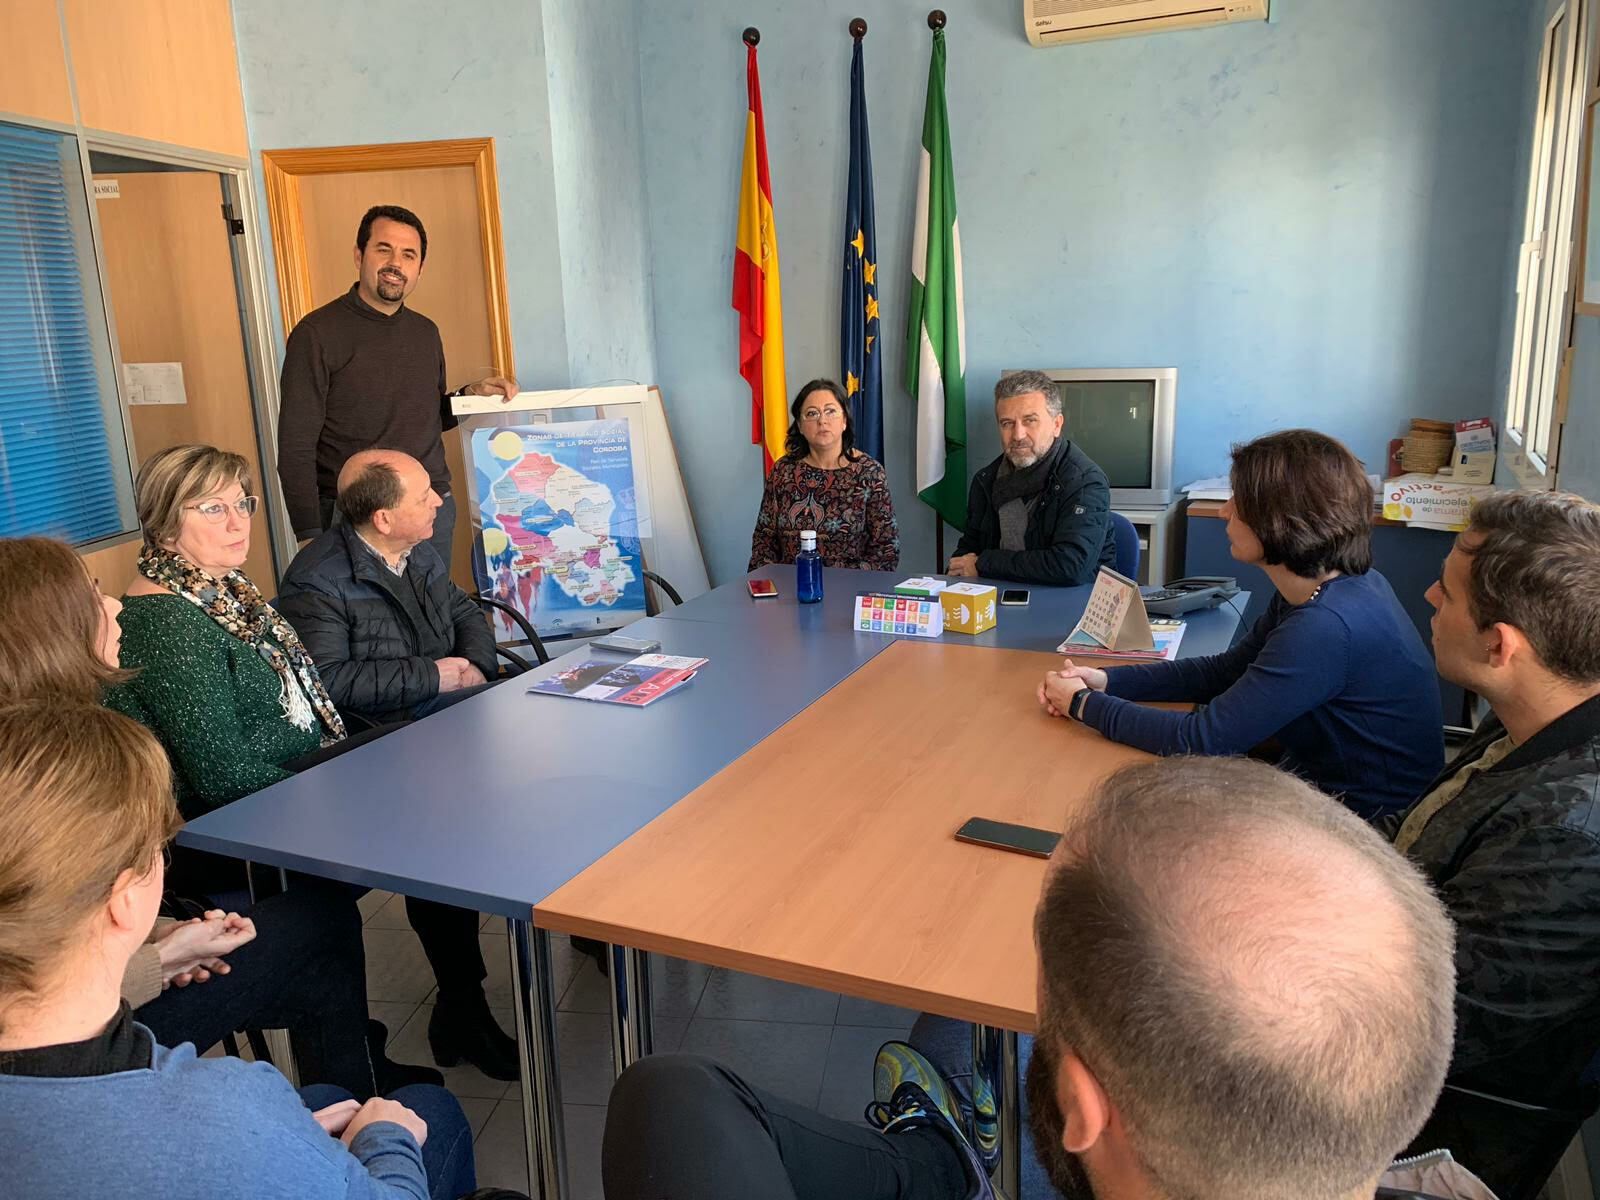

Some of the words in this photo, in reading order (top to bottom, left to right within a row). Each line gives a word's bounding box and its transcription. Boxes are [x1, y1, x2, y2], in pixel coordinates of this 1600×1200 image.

[101, 185, 118, 193] SOCIAL
[527, 432, 553, 442] ZONAS
[567, 439, 577, 447] LA
[578, 436, 616, 446] PROVINCIA
[1391, 483, 1443, 501] activo
[1405, 496, 1469, 508] ejecimiento
[1433, 507, 1469, 517] grama
